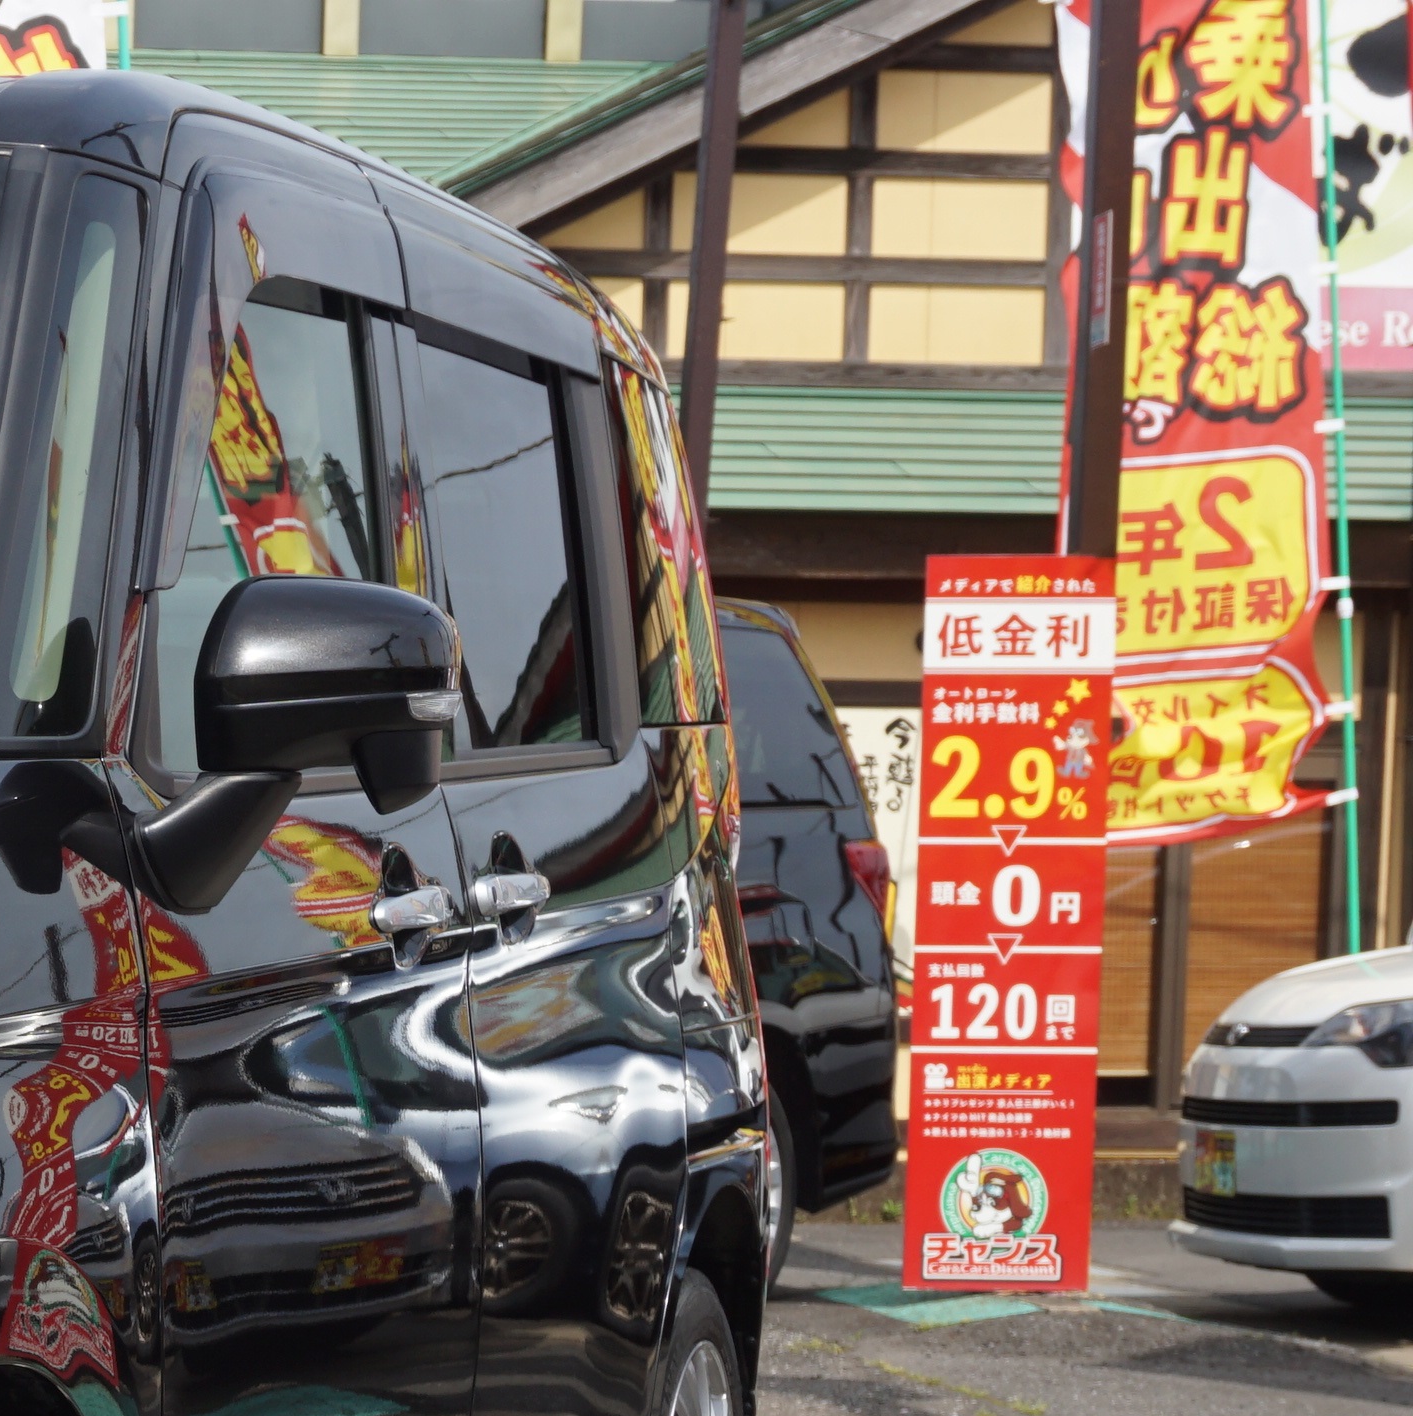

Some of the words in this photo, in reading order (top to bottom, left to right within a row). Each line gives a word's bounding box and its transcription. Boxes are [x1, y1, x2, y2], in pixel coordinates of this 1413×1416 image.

[939, 575, 1095, 593] メディアで紹介された
[938, 613, 1091, 658] 低金利
[933, 687, 1017, 700] オートローン
[932, 702, 1040, 724] 金利手数料
[929, 963, 985, 978] 支払回数
[927, 1236, 1054, 1264] チャンス
